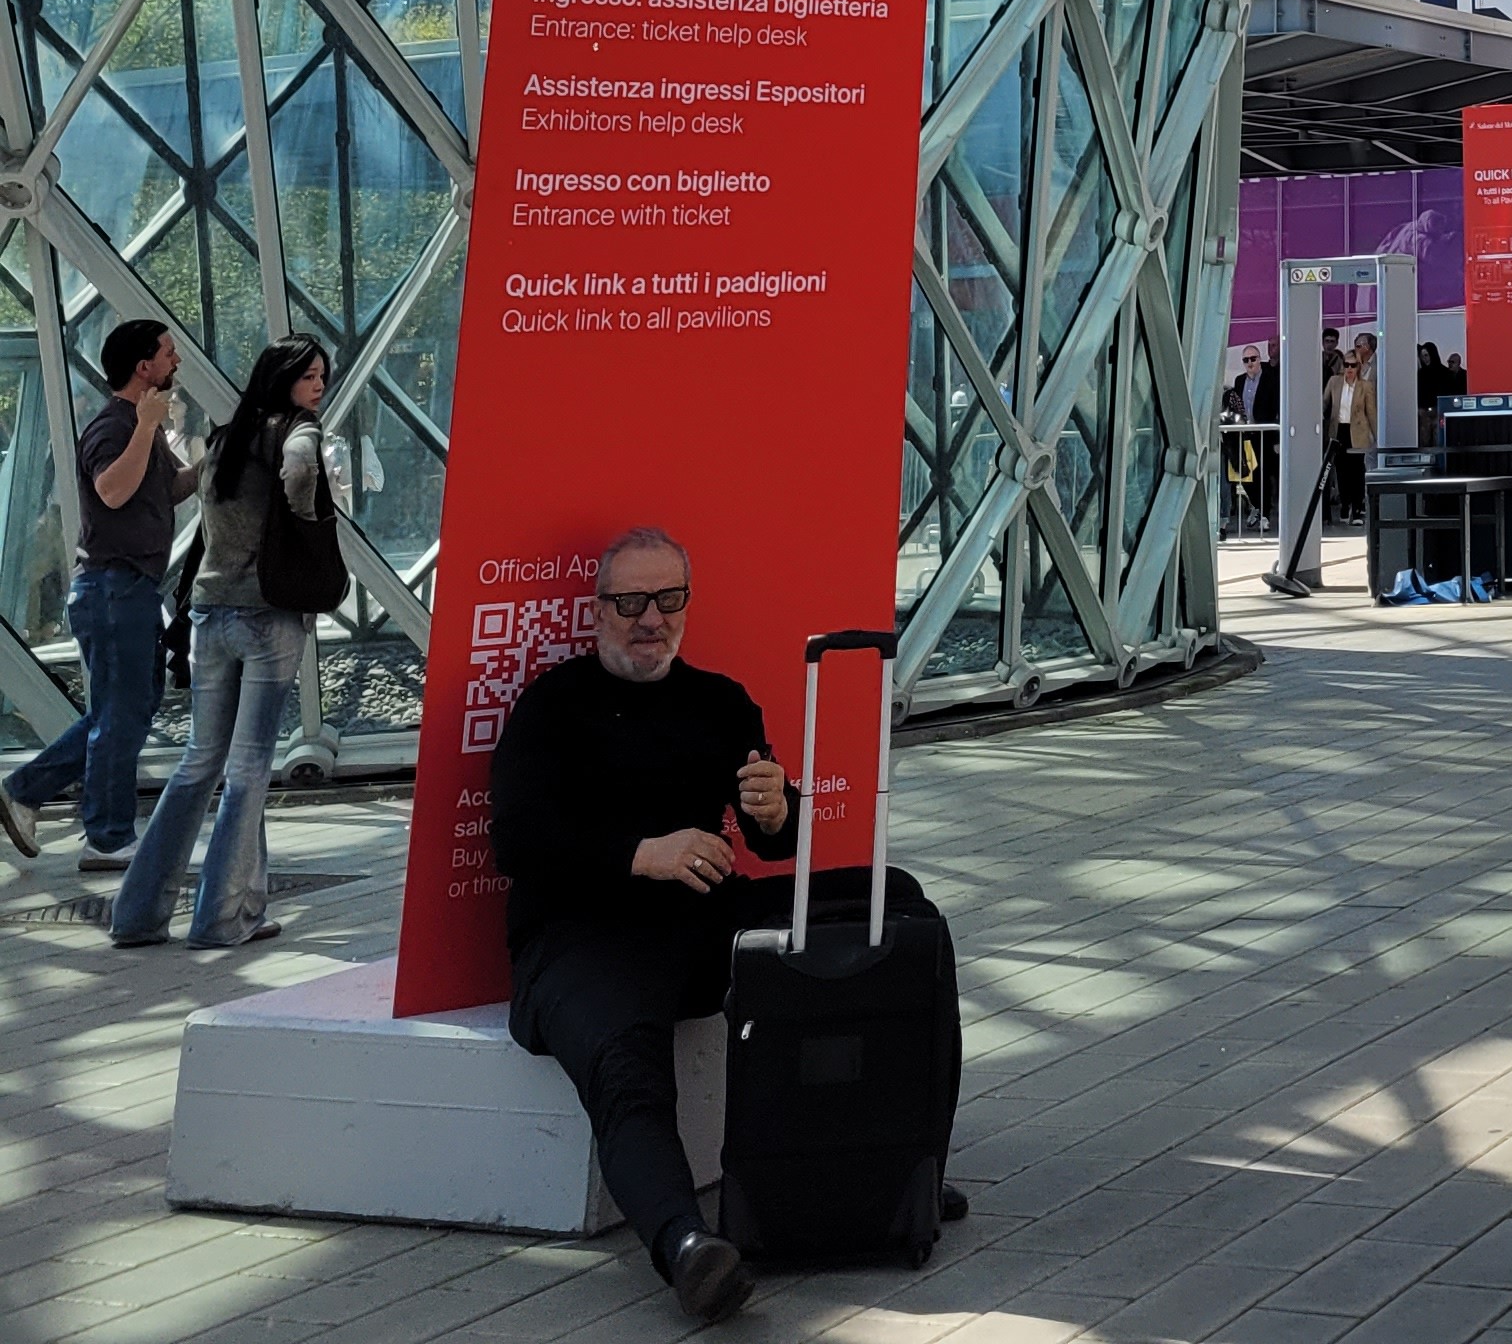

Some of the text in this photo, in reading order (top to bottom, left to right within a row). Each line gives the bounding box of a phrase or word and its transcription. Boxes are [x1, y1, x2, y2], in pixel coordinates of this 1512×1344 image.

[530, 14, 808, 49] Entrance: ticket help desk
[523, 73, 865, 107] Assistenza ingressi Espositori
[521, 107, 744, 137] Exhibitors help desk
[515, 168, 771, 197] Ingresso con biglietto
[1474, 169, 1510, 181] QUICK
[512, 203, 732, 226] Entrance with ticket
[505, 270, 827, 299] Quick link a tutti i padiglioni
[502, 305, 771, 334] Quick link to all pavilions
[480, 555, 560, 584] Official
[452, 848, 489, 869] Buy
[448, 880, 468, 897] or
